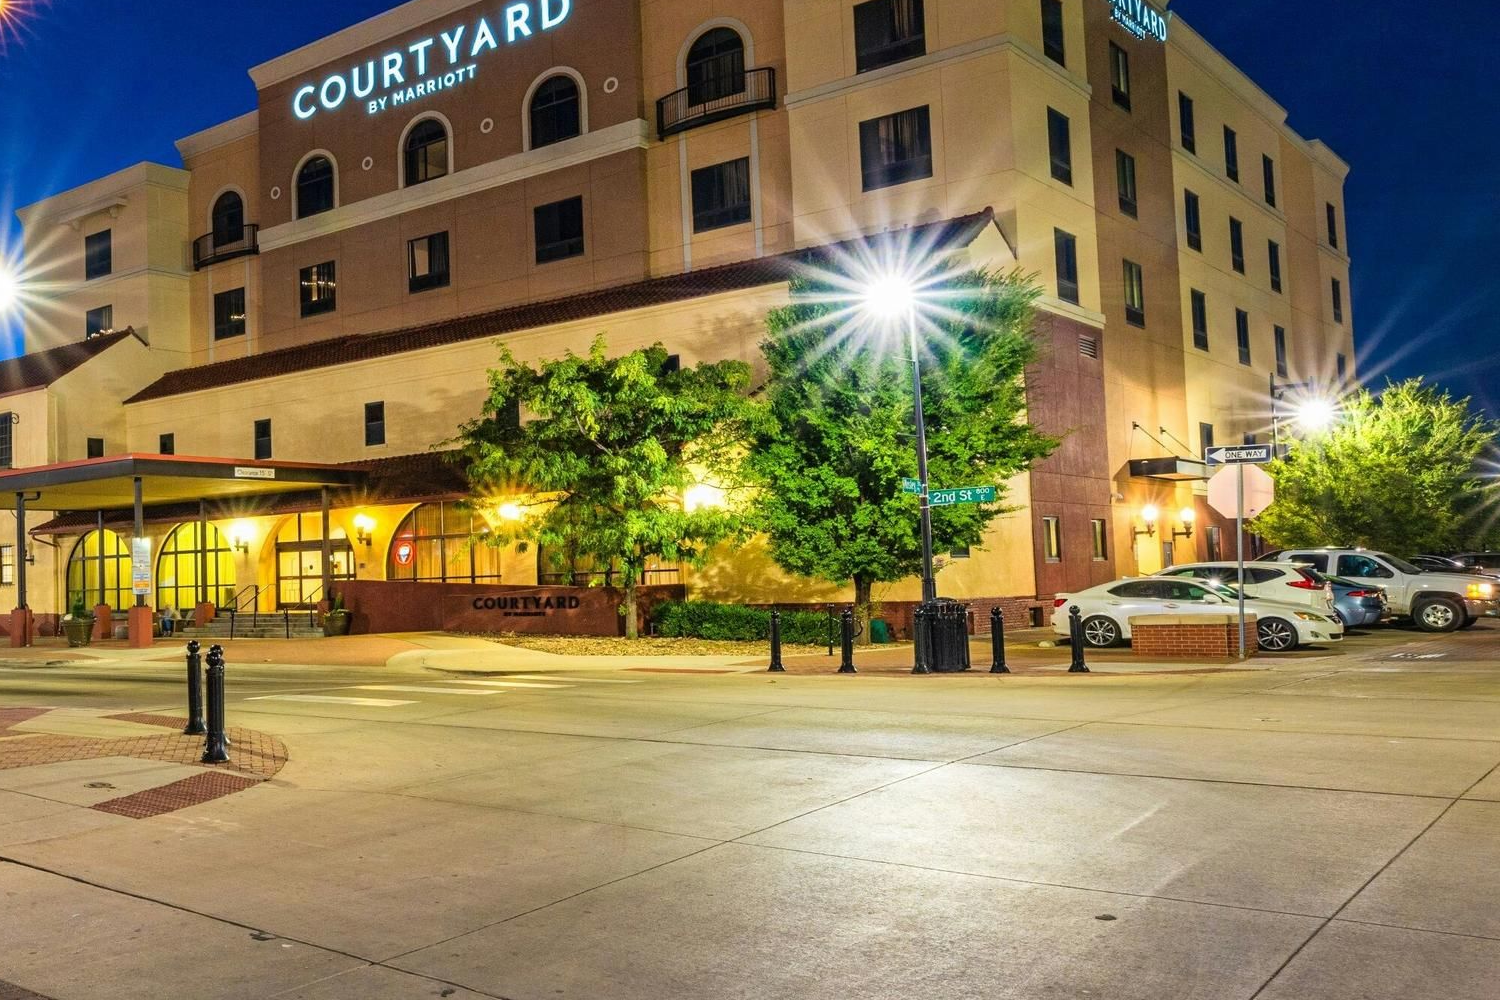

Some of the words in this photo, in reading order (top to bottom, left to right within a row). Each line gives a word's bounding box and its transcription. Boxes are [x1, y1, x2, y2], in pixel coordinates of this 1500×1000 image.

[368, 96, 389, 114] BY
[392, 64, 477, 106] MARRIOTT
[1225, 451, 1242, 459] ONE
[1245, 450, 1264, 458] WAY
[933, 491, 956, 503] 2nd
[959, 489, 973, 501] St
[472, 595, 580, 610] COURTYARD
